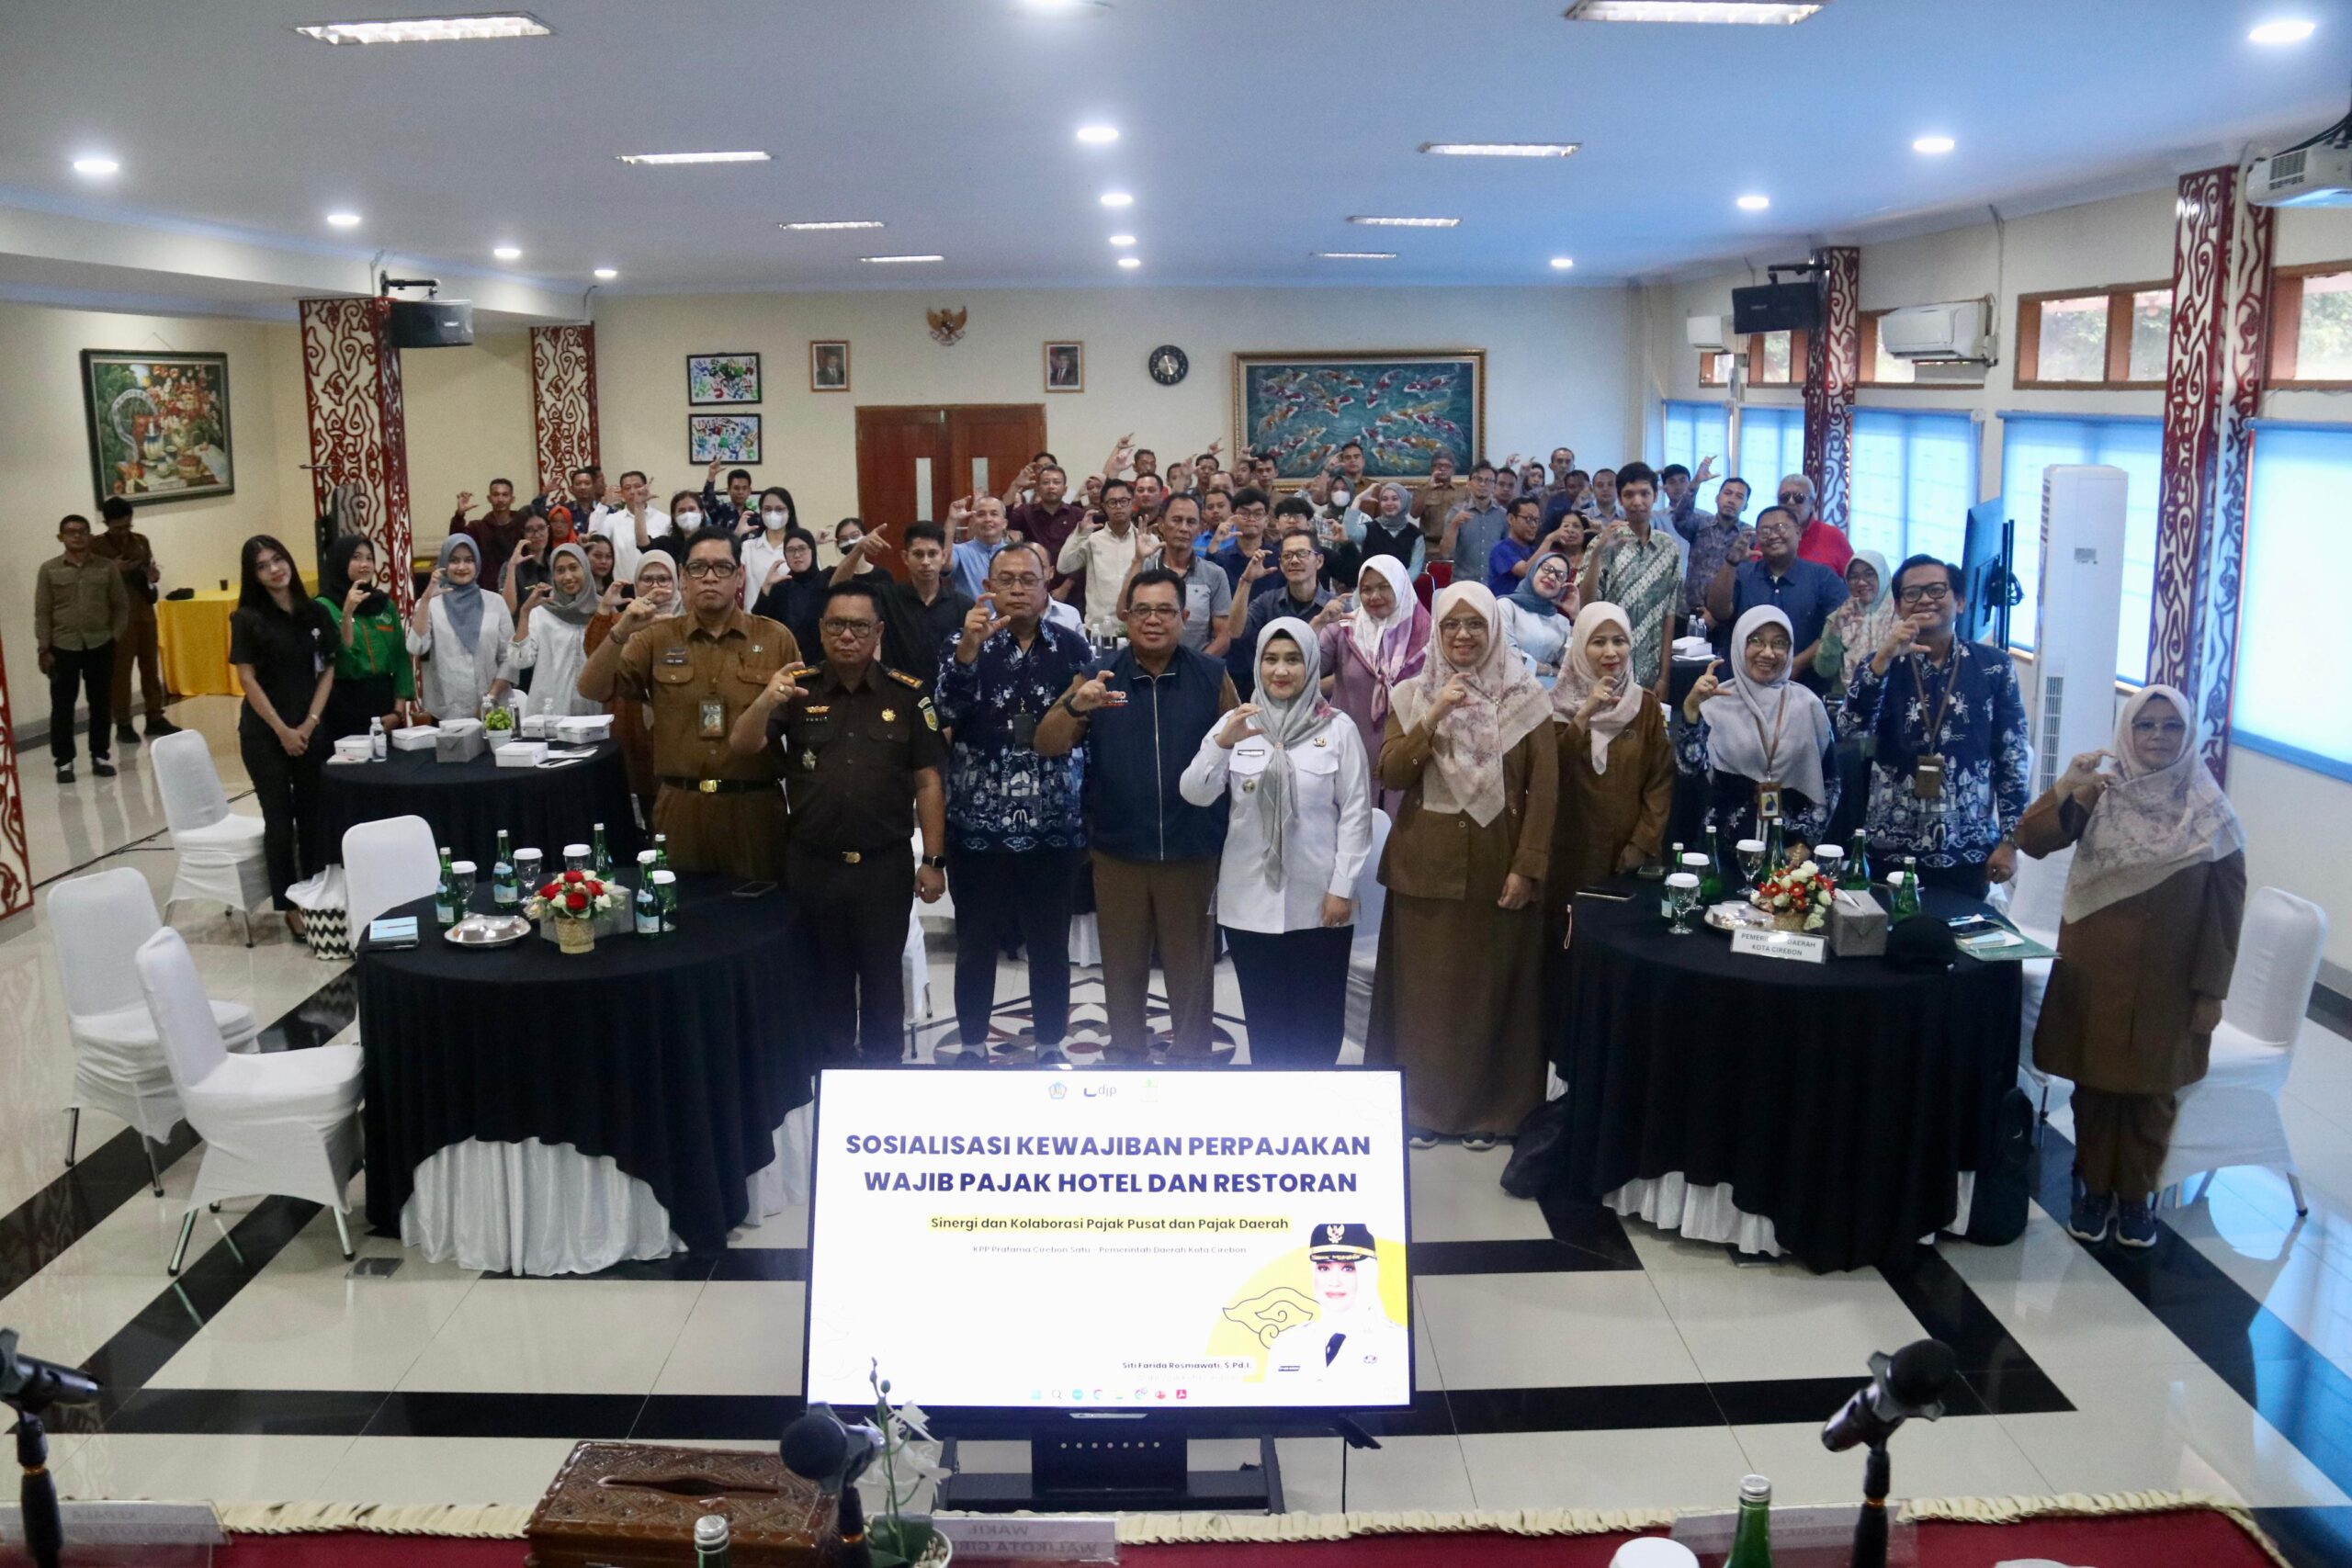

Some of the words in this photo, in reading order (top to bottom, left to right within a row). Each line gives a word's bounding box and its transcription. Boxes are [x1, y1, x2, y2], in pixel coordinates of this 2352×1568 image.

[1752, 944, 1770, 953] KOTA
[1771, 946, 1803, 955] CIREBON
[1787, 939, 1816, 948] DAERAH
[846, 1134, 1011, 1156] SOSIALISASI
[1016, 1136, 1182, 1156] KEWAJIBAN
[1188, 1135, 1371, 1156] PERPAJAKAN
[864, 1171, 955, 1192] WAJIB
[959, 1172, 1052, 1192] PAJAK
[1057, 1173, 1143, 1193] HOTEL
[1148, 1173, 1207, 1193] DAN
[1213, 1172, 1357, 1193] RESTORAN
[931, 1217, 978, 1232] Sinergi
[981, 1218, 1007, 1229] dan
[1011, 1218, 1083, 1229] Kolaborasi
[1087, 1218, 1124, 1232] Pajak
[1127, 1219, 1165, 1229] Pusat
[1169, 1219, 1195, 1229] dan
[1198, 1218, 1235, 1232] Pajak
[1239, 1218, 1288, 1229] Daerah
[1099, 1246, 1152, 1254] Pemerintah
